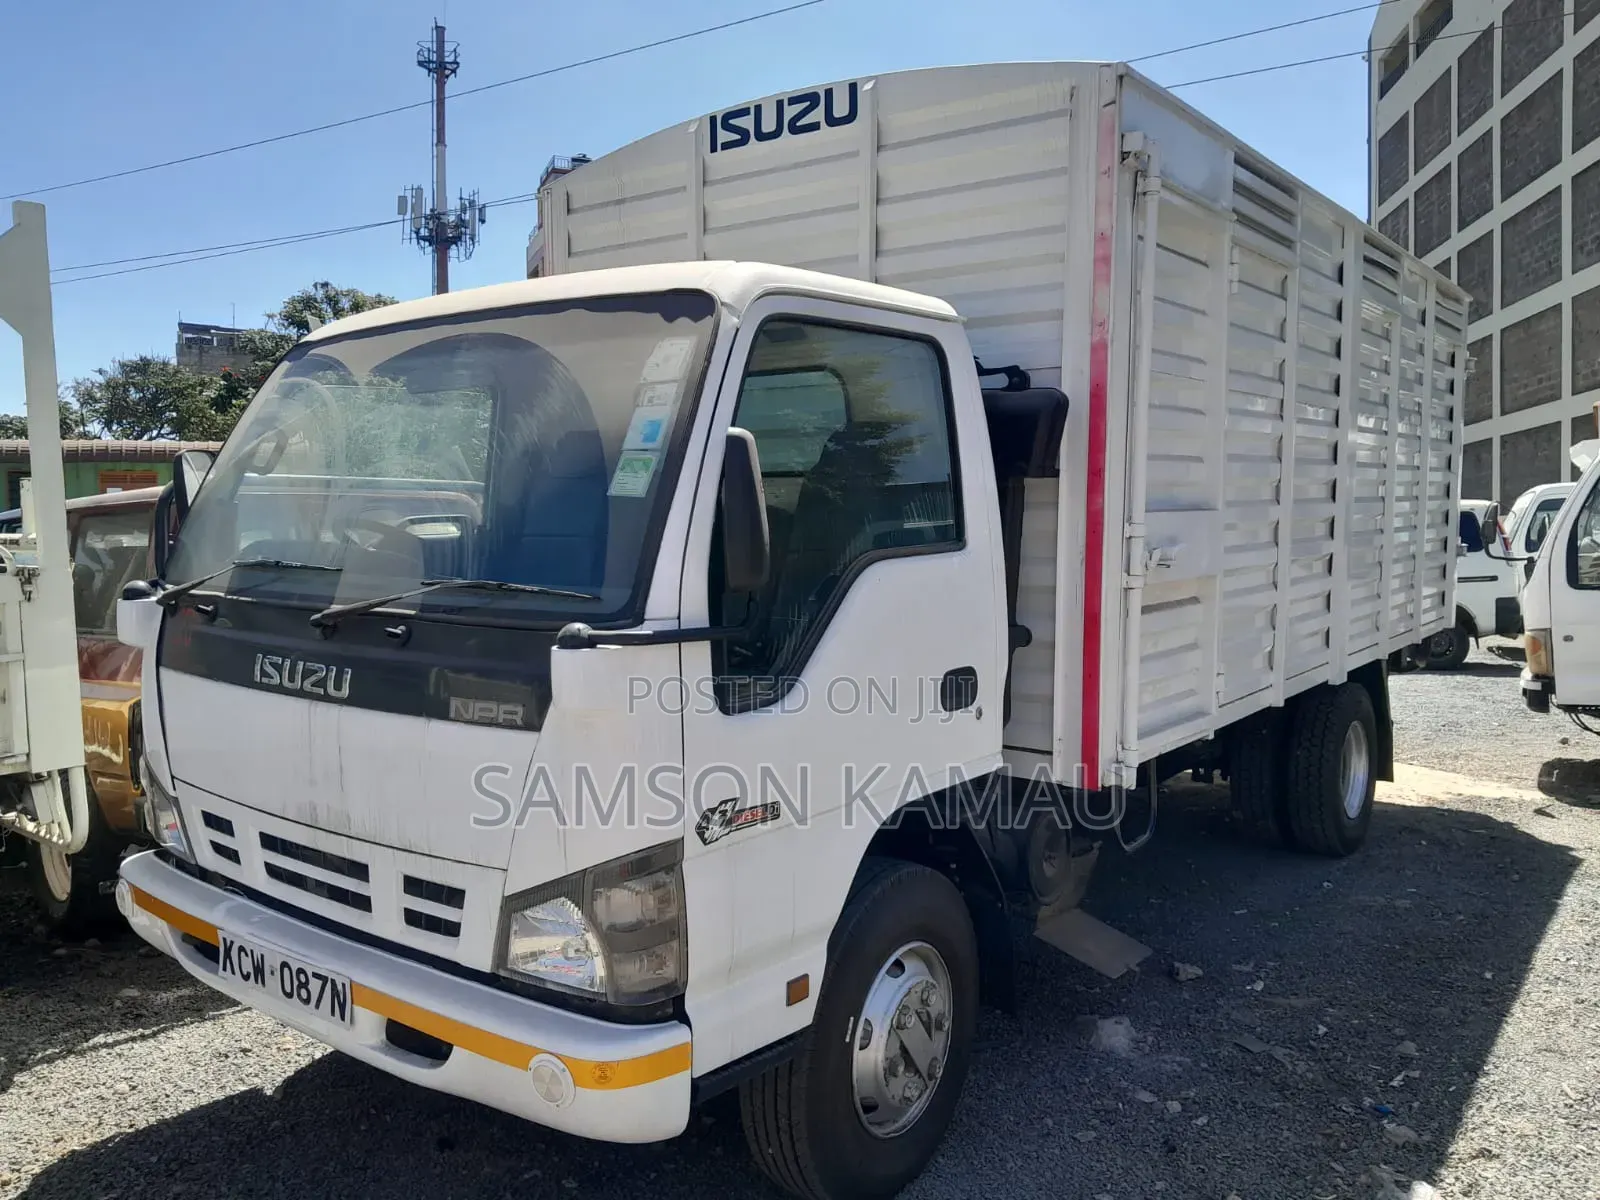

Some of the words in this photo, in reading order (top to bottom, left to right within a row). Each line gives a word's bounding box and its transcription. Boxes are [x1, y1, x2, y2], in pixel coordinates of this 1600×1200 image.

[709, 82, 858, 153] ISUZU
[254, 653, 352, 699] ISUZU
[449, 697, 526, 727] NPR
[222, 937, 266, 988] KCW
[279, 960, 347, 1022] 087N
